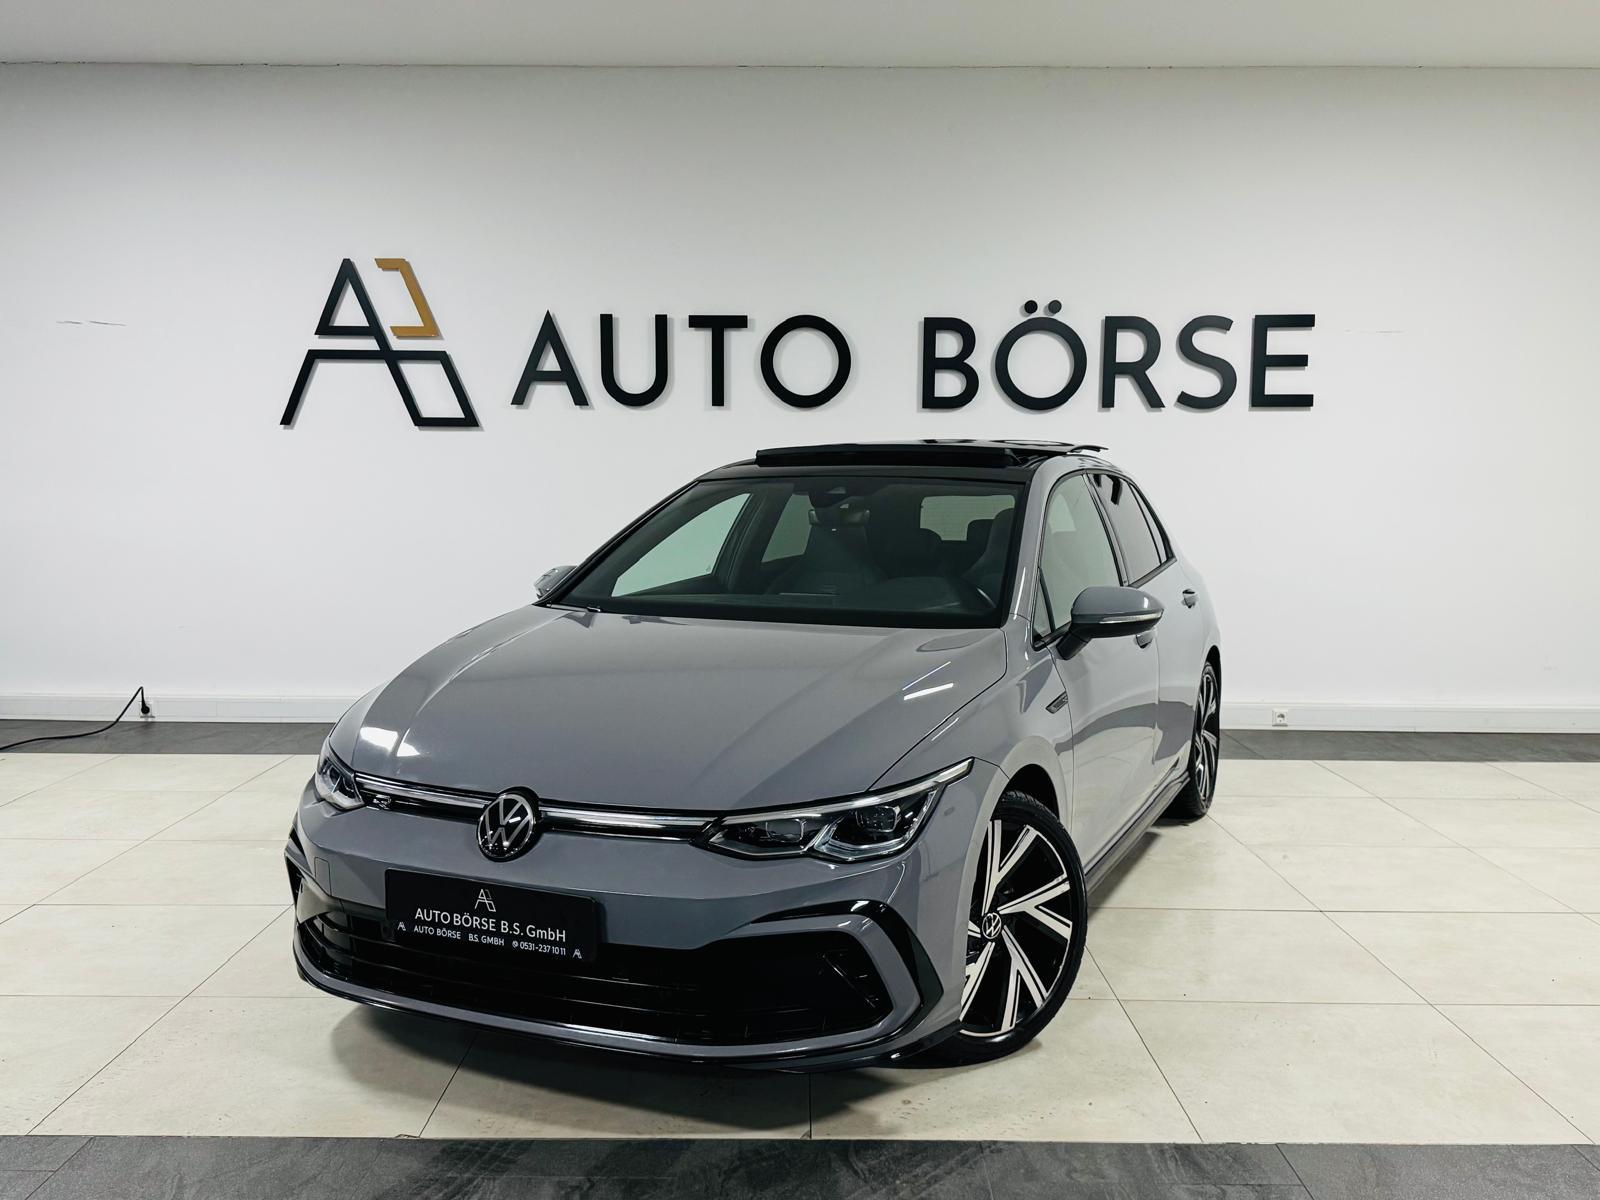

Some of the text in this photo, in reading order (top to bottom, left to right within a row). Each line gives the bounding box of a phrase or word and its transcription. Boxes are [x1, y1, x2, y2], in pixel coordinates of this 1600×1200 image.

[510, 299, 1316, 411] AUTO BÖRSE
[413, 925, 435, 935] AUTO
[436, 928, 462, 940] BÖRSE
[481, 935, 505, 947] GMBH
[500, 920, 524, 936] B.S.
[526, 924, 566, 943] GmbH
